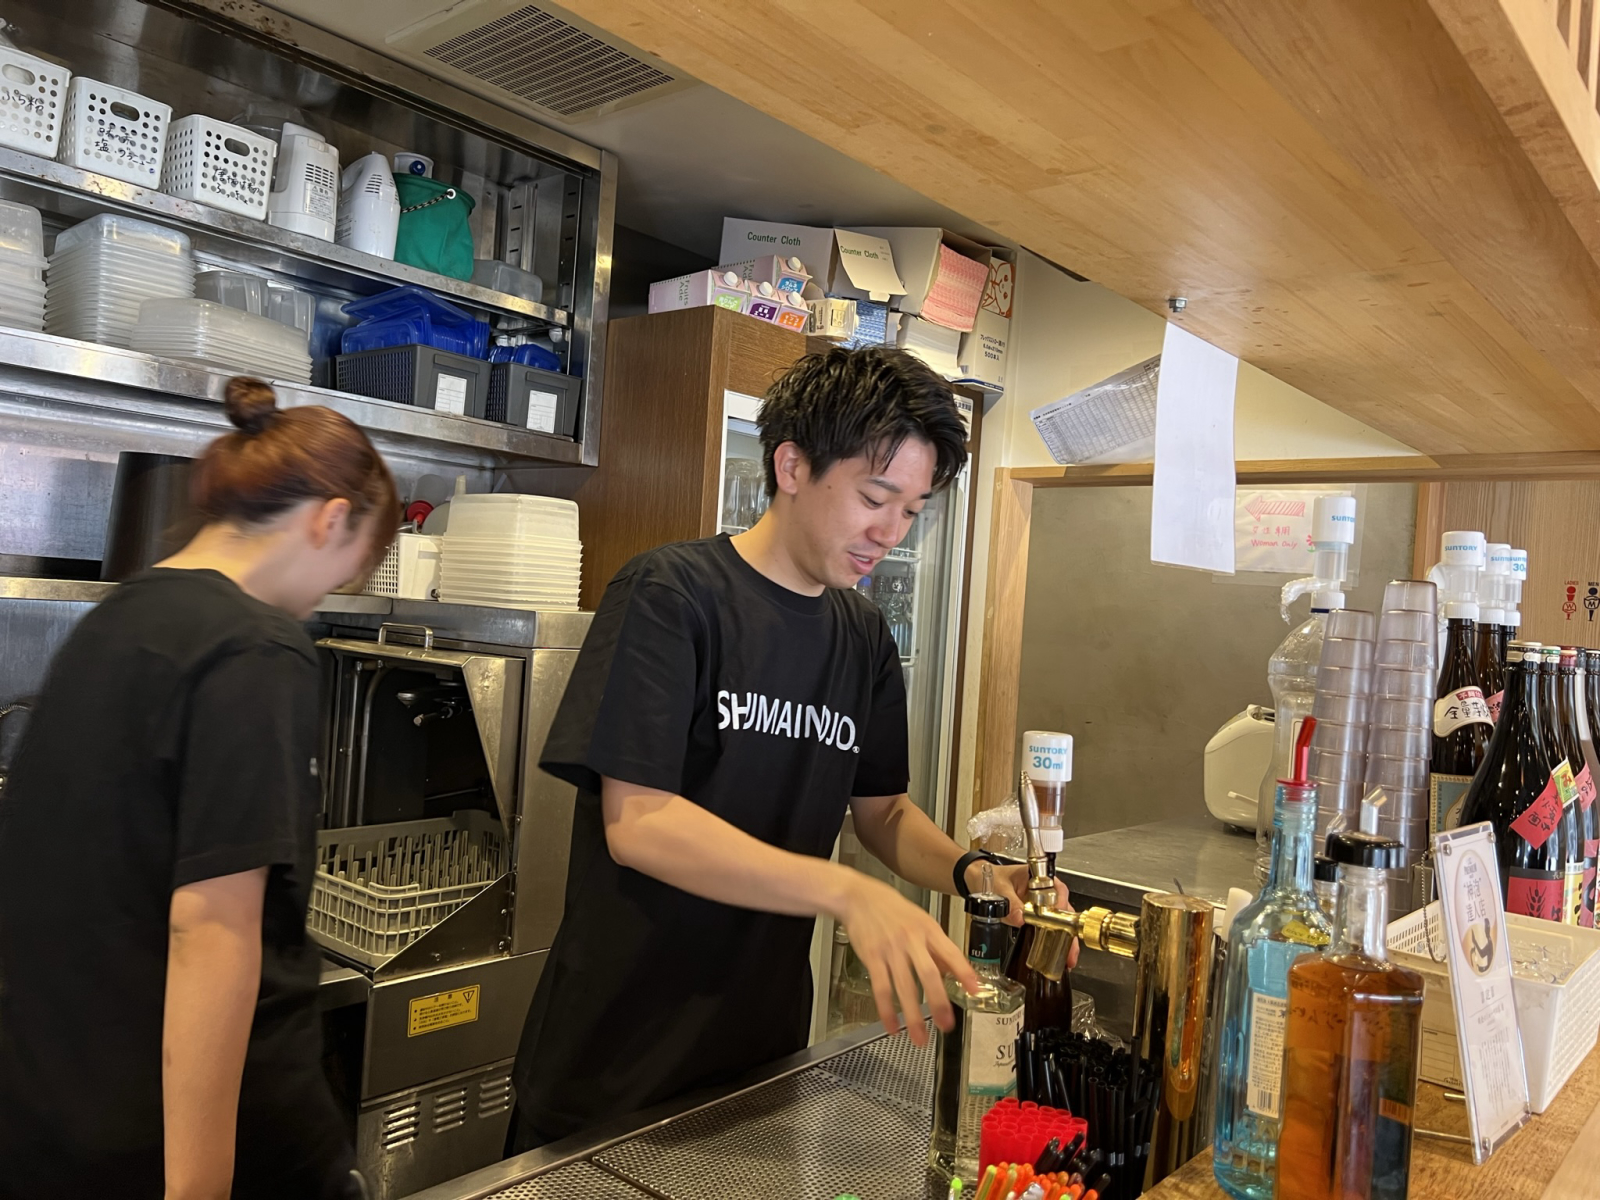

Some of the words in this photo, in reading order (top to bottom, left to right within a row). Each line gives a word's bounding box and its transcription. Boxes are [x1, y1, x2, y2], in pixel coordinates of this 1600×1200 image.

[747, 232, 777, 243] Counter
[781, 235, 801, 246] Cloth
[840, 245, 862, 257] Counter
[864, 250, 879, 259] Cloth
[1251, 539, 1278, 547] Woman
[1281, 541, 1298, 550] Only
[1029, 745, 1067, 754] SUNTORY
[1033, 756, 1063, 769] 30ml
[996, 1043, 1014, 1060] SU
